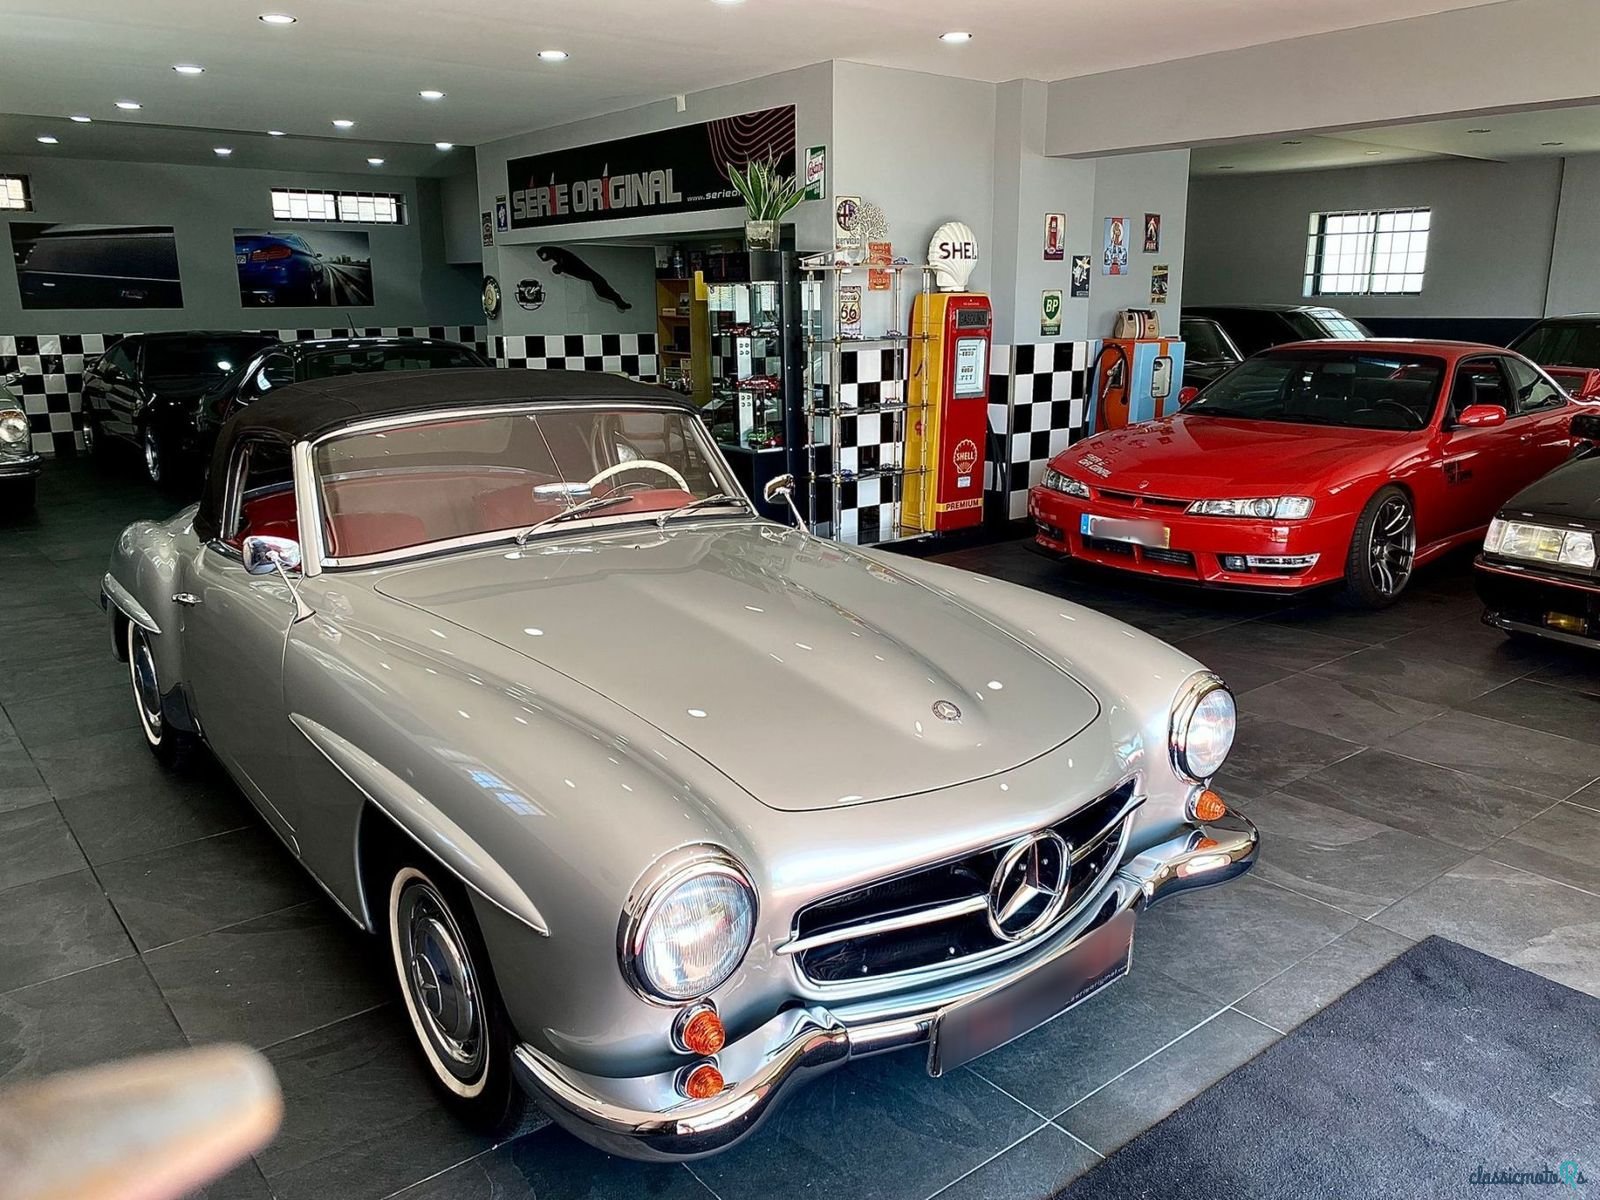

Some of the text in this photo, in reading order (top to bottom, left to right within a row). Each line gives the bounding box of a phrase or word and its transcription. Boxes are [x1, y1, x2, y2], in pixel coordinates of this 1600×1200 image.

[572, 163, 682, 213] ORIGINAL
[841, 303, 857, 320] 66
[1046, 299, 1058, 313] BP
[956, 451, 975, 461] SHELL
[945, 499, 979, 511] PREMIUM
